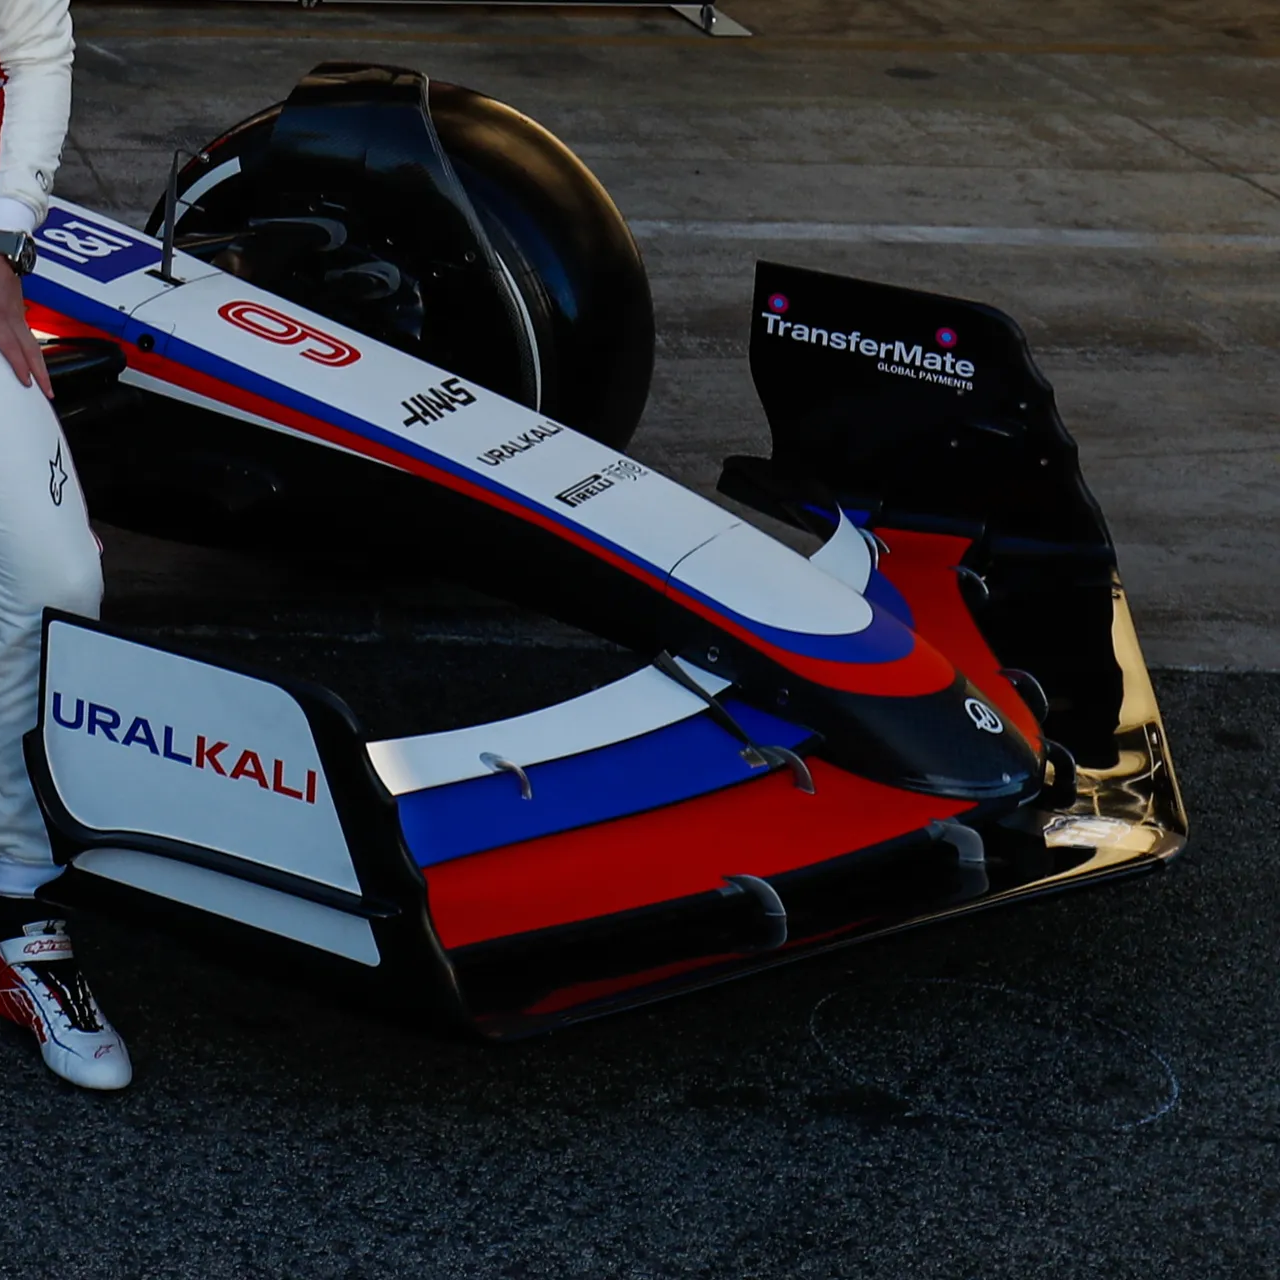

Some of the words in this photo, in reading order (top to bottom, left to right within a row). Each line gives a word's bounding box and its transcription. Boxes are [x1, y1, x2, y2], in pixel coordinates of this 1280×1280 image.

[217, 298, 362, 368] 9
[761, 312, 975, 378] TransferMate
[877, 362, 917, 379] GLOBAL
[918, 372, 974, 391] PAYMENTS
[402, 377, 478, 428] HAAS
[476, 420, 564, 467] URALKALI
[554, 473, 616, 508] PIRELLI
[51, 690, 318, 806] URALKALI
